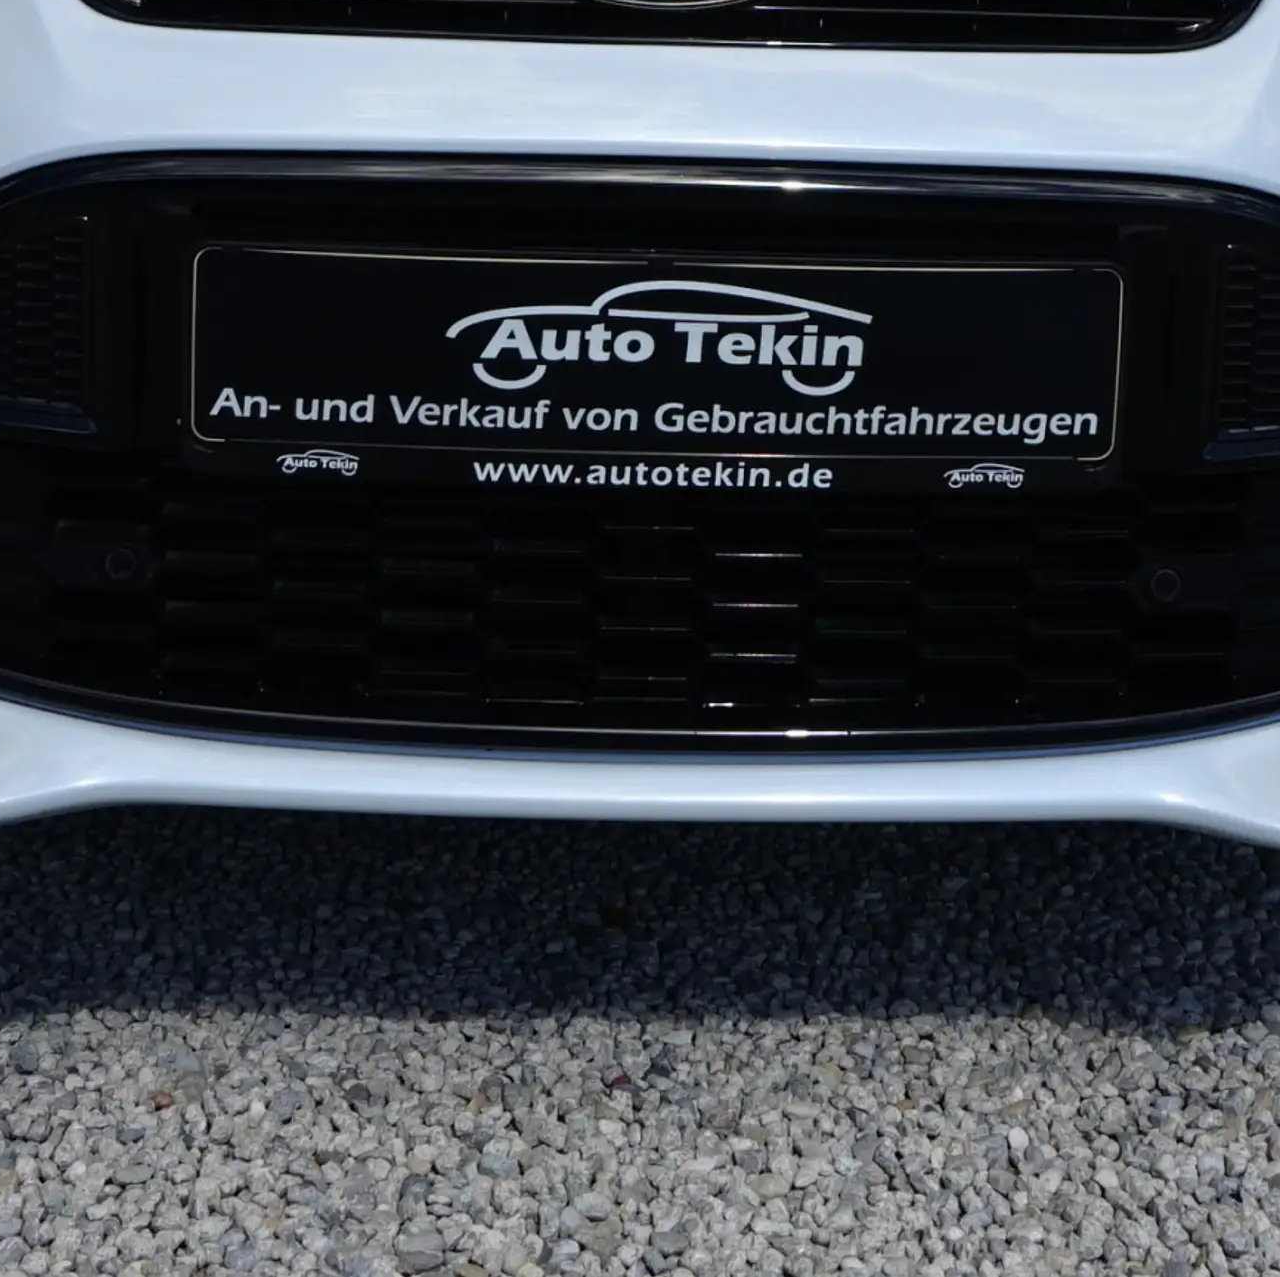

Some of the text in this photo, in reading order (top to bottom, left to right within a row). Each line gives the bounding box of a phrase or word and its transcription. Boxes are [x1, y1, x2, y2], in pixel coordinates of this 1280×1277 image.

[479, 318, 864, 368] Auto Tekin
[209, 387, 1098, 444] An- und Verkauf von Gebrauchtfahrzeugen
[283, 457, 318, 468] Auto
[472, 461, 833, 489] www.autotekin.de
[950, 471, 984, 483] Auto
